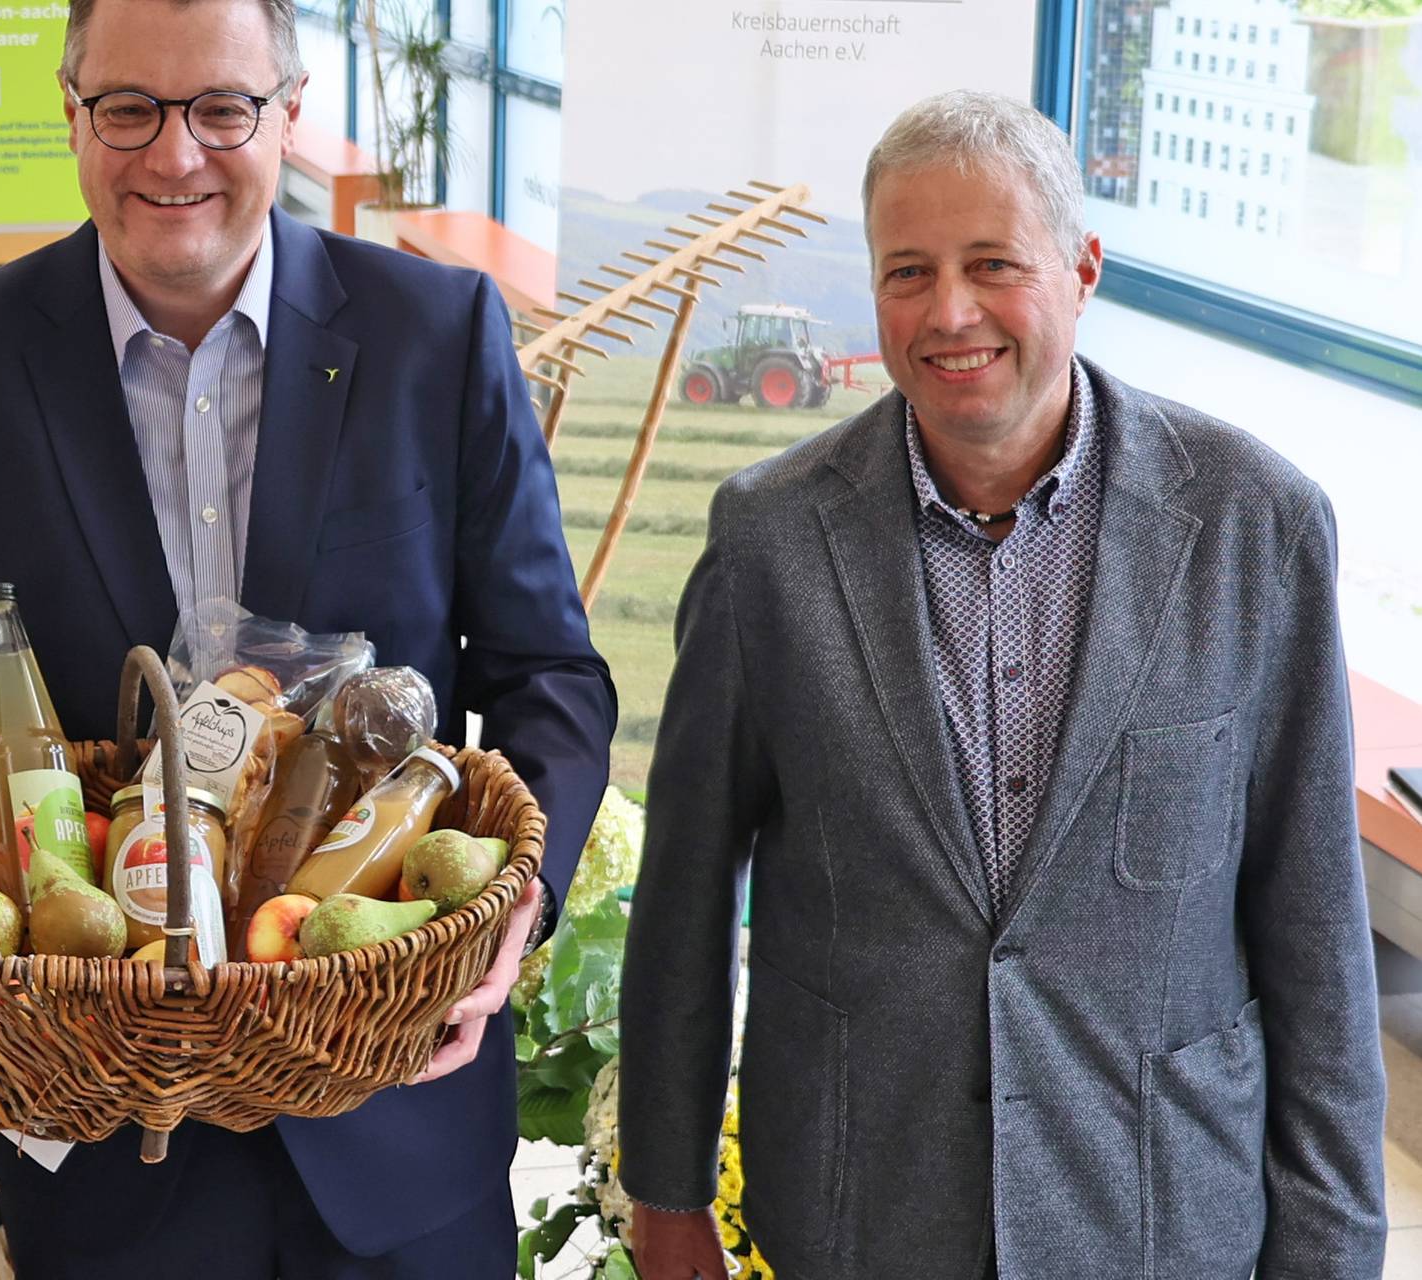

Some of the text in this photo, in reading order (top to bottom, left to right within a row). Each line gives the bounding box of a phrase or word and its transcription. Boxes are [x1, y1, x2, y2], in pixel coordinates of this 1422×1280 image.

[731, 11, 901, 35] Kreisbauernschaft
[760, 39, 867, 61] Aachen e.V.
[191, 711, 236, 740] Apfelchips
[54, 818, 88, 846] APFE
[125, 867, 164, 889] APFE
